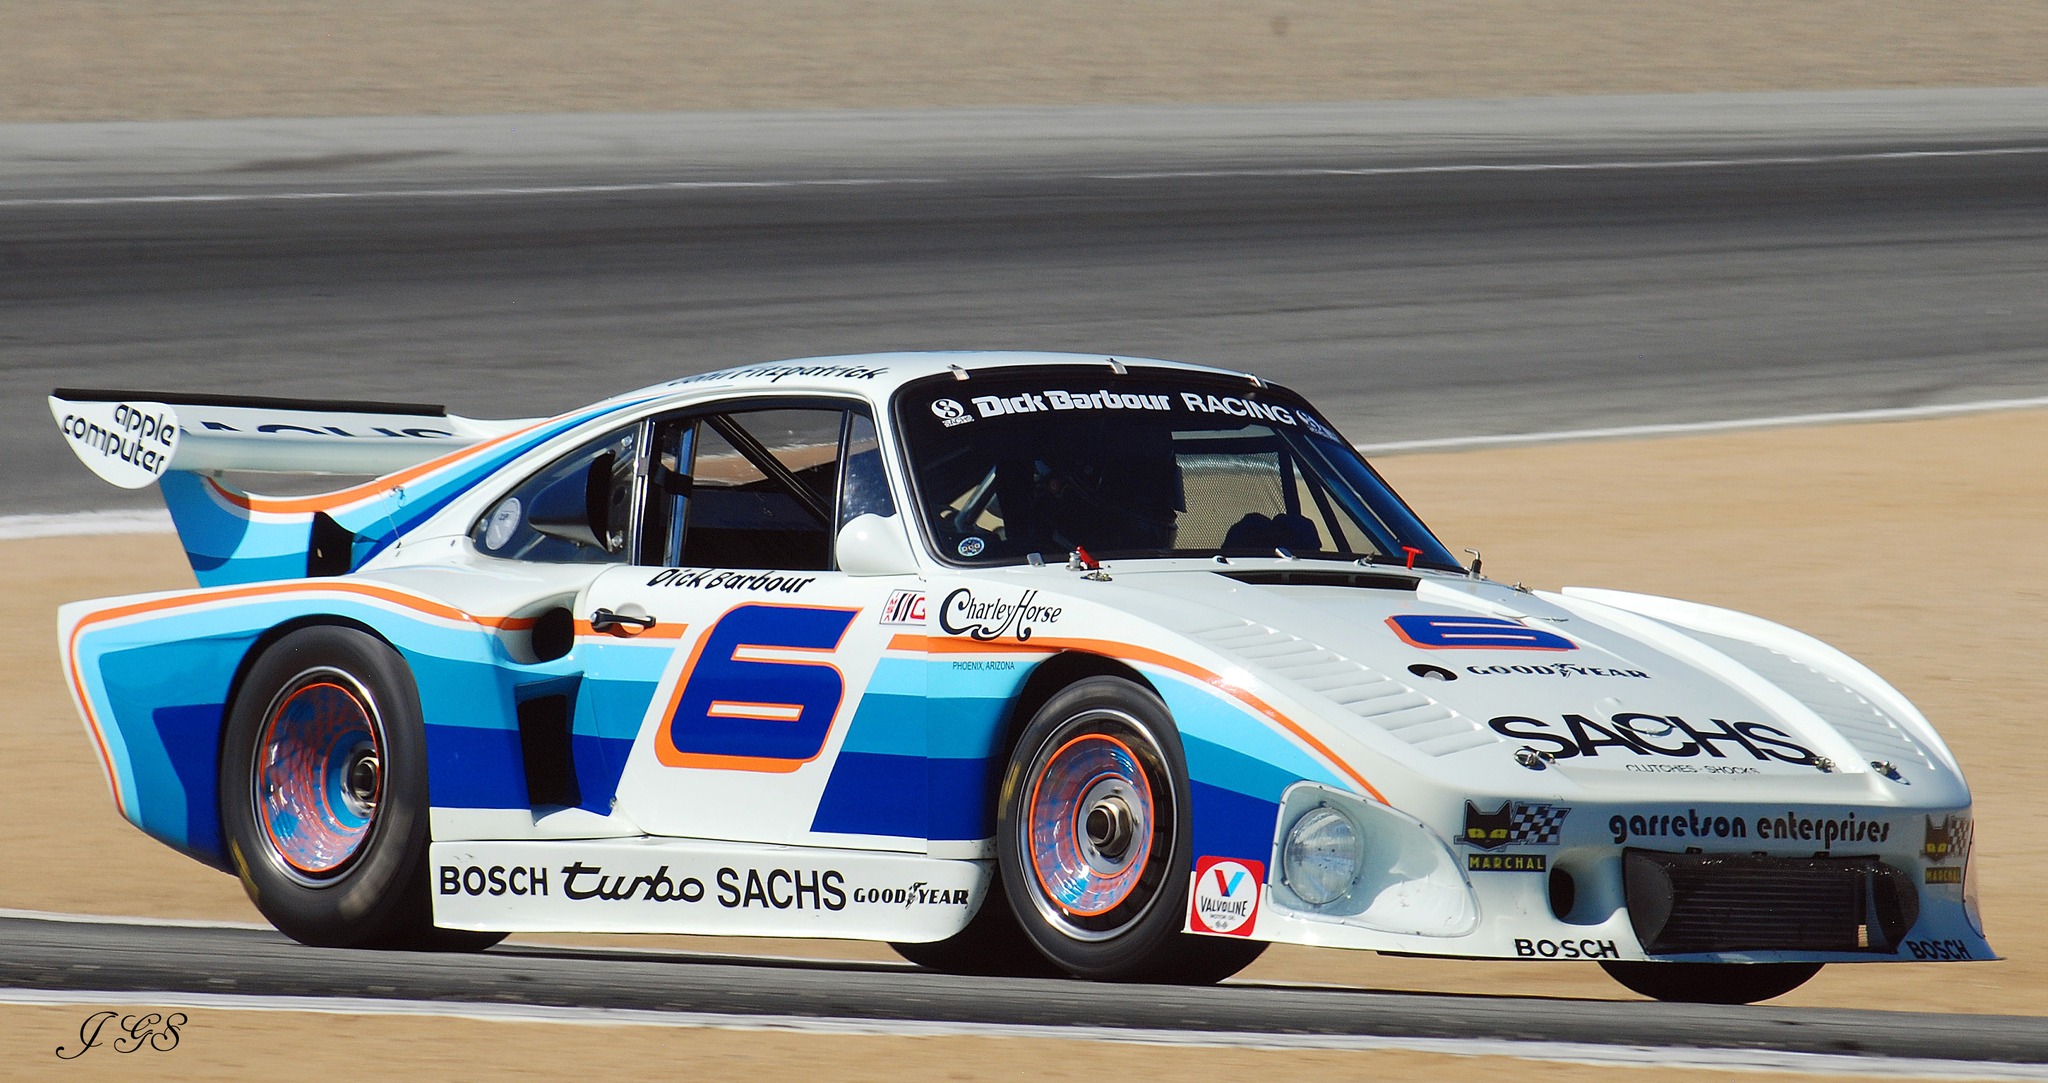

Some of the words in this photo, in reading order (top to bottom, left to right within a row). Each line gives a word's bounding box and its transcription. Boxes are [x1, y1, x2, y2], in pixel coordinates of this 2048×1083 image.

[115, 404, 175, 447] apple
[971, 393, 1049, 418] Dick
[1043, 390, 1170, 411] Barbour
[1180, 392, 1297, 426] RACING
[63, 414, 165, 475] computer
[647, 568, 716, 588] Dick
[705, 570, 816, 593] Barbour
[1384, 615, 1580, 652] 6
[953, 661, 984, 671] PHOENIX,
[985, 661, 1015, 670] ARIZONA
[654, 601, 865, 774] 6
[1488, 712, 1823, 770] SACHS
[1609, 809, 1747, 845] garretson
[1757, 811, 1891, 849] enterprises
[1469, 856, 1544, 870] MARCHAL
[440, 865, 548, 896] BOSCH
[561, 861, 705, 902] turbo
[716, 867, 847, 911] SACHS
[1201, 896, 1248, 917] VALVOLINE
[1514, 938, 1621, 958] BOSCH
[1906, 939, 1973, 960] BOSCH
